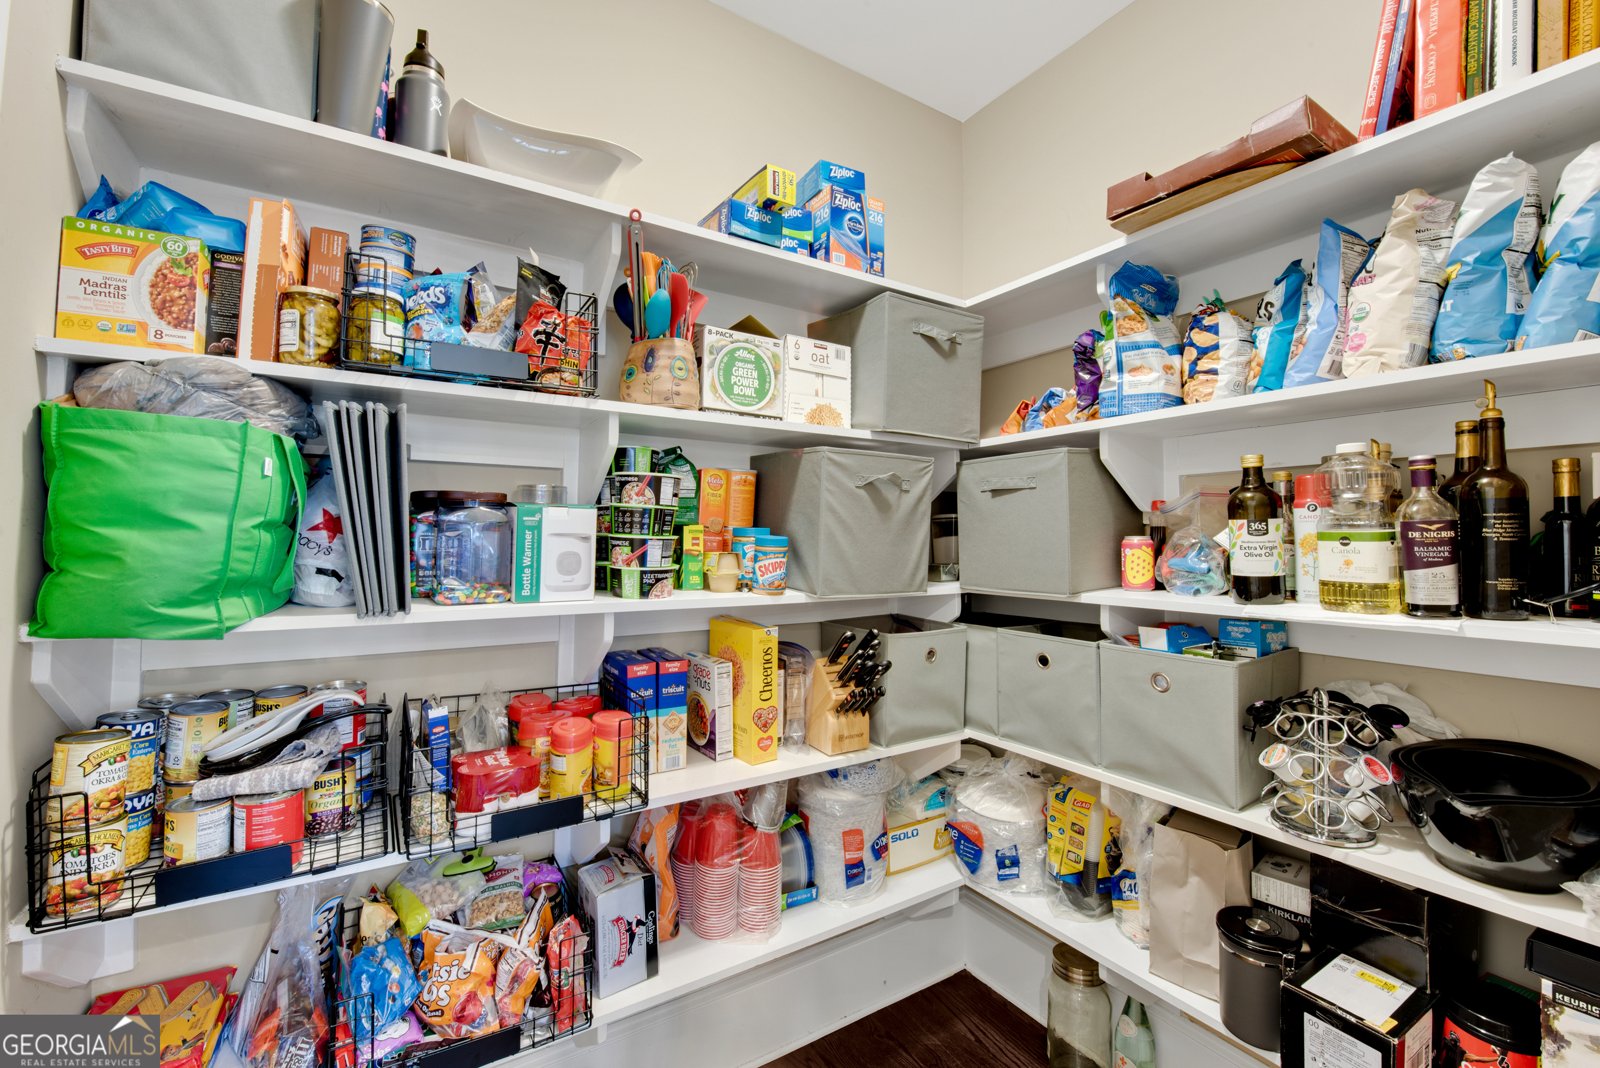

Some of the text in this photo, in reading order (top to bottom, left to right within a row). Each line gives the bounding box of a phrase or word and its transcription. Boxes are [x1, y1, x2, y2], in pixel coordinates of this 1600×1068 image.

[830, 165, 855, 179] Ziploc
[834, 192, 861, 212] Ziploc
[747, 206, 772, 224] Ziploc
[815, 208, 829, 225] 216
[868, 210, 883, 224] 216
[76, 220, 156, 241] ORGANIC
[81, 243, 133, 256] TASTY BITE
[166, 240, 183, 252] 60
[214, 253, 244, 262] GODIVA
[79, 277, 128, 292] Madras
[102, 275, 128, 284] INDIAN
[83, 287, 127, 300] Lentils
[153, 329, 164, 340] 8
[707, 328, 734, 340] 8-PACK
[794, 339, 801, 350] 6
[559, 358, 579, 369] SHIN
[810, 352, 831, 366] oat
[734, 361, 756, 371] ORGANIC
[732, 368, 758, 379] GREEN
[730, 377, 760, 389] POWER
[733, 386, 757, 397] BOWL
[1248, 521, 1267, 532] 365
[1408, 530, 1455, 539] DE NIGRIS
[1239, 543, 1278, 554] Extra Virgin
[1263, 550, 1274, 558] Oil
[1331, 545, 1361, 556] Canola
[521, 529, 533, 596] Bottle Warmer
[692, 663, 712, 680] grape
[759, 646, 773, 703] Cheerios
[630, 688, 653, 699] triscuit
[662, 685, 685, 694] triscuit
[91, 774, 116, 787] OKRA
[1073, 799, 1091, 810] GLAD
[890, 828, 919, 844] SOLO
[1268, 905, 1312, 925] KIRKLAN
[617, 917, 628, 940] GINGER
[646, 910, 655, 945] Goslings
[1555, 992, 1600, 1014] KEURIG
